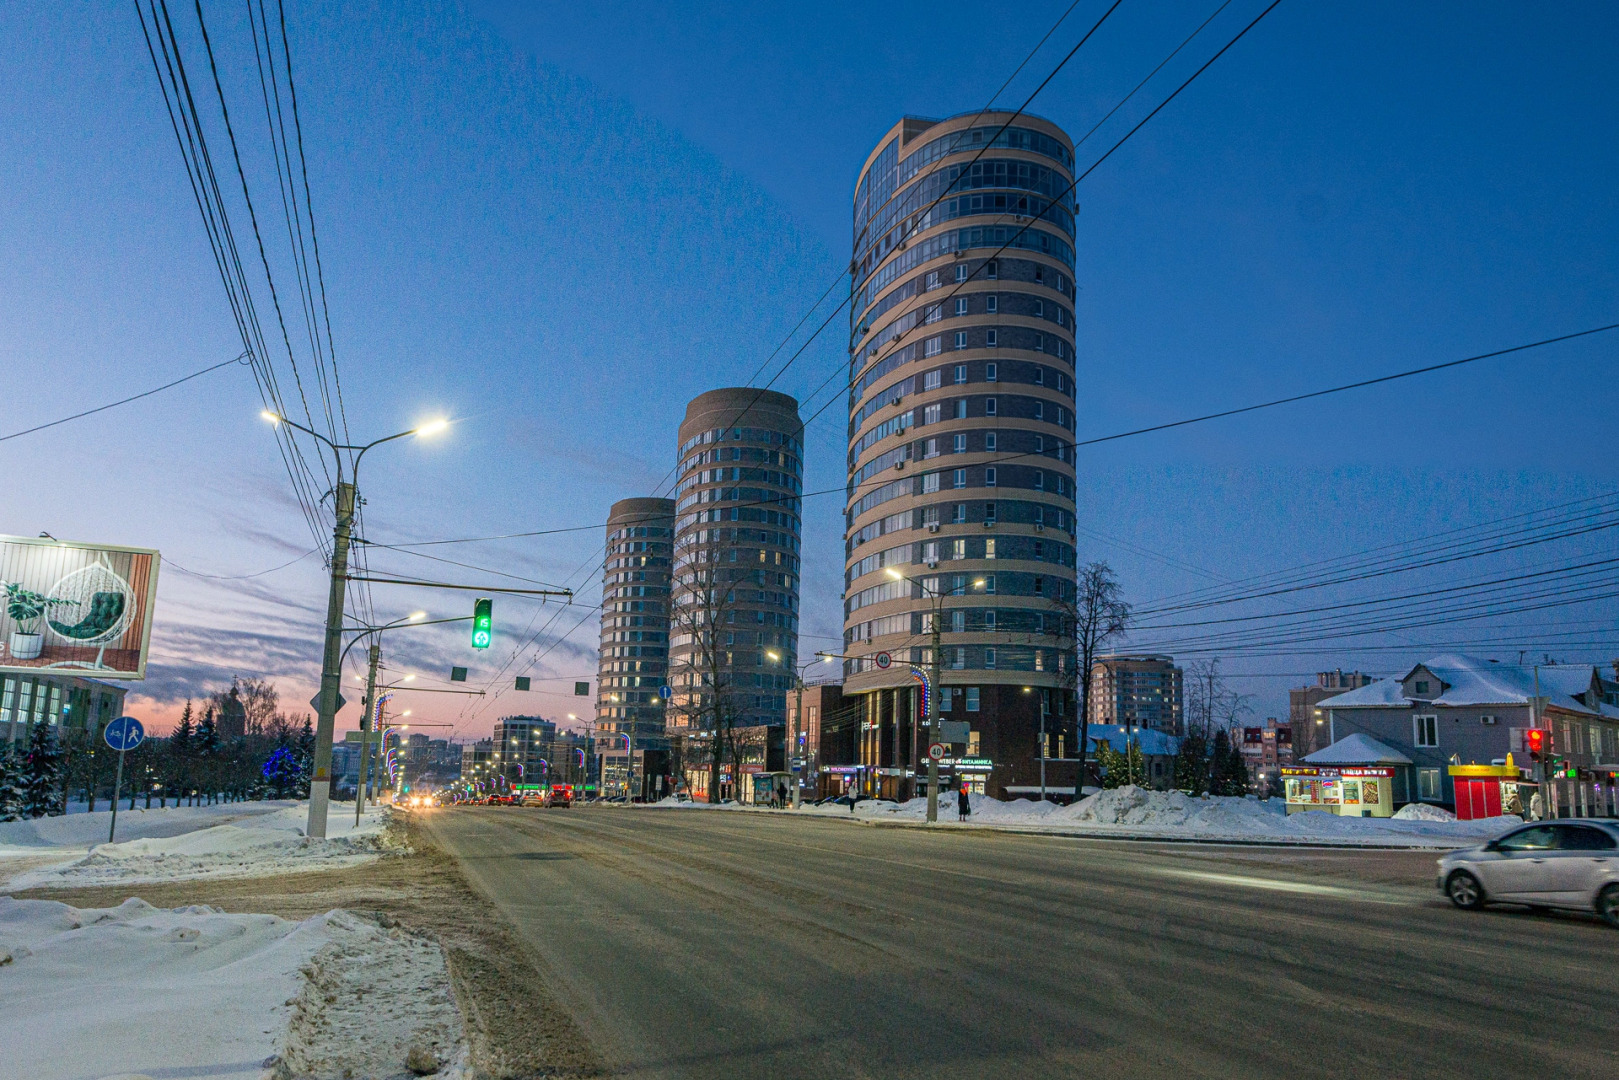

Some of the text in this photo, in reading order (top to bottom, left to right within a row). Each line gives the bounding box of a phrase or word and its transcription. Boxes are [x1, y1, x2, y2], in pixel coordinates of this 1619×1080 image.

[480, 618, 489, 628] 15
[879, 655, 888, 665] 40
[931, 748, 941, 756] 40
